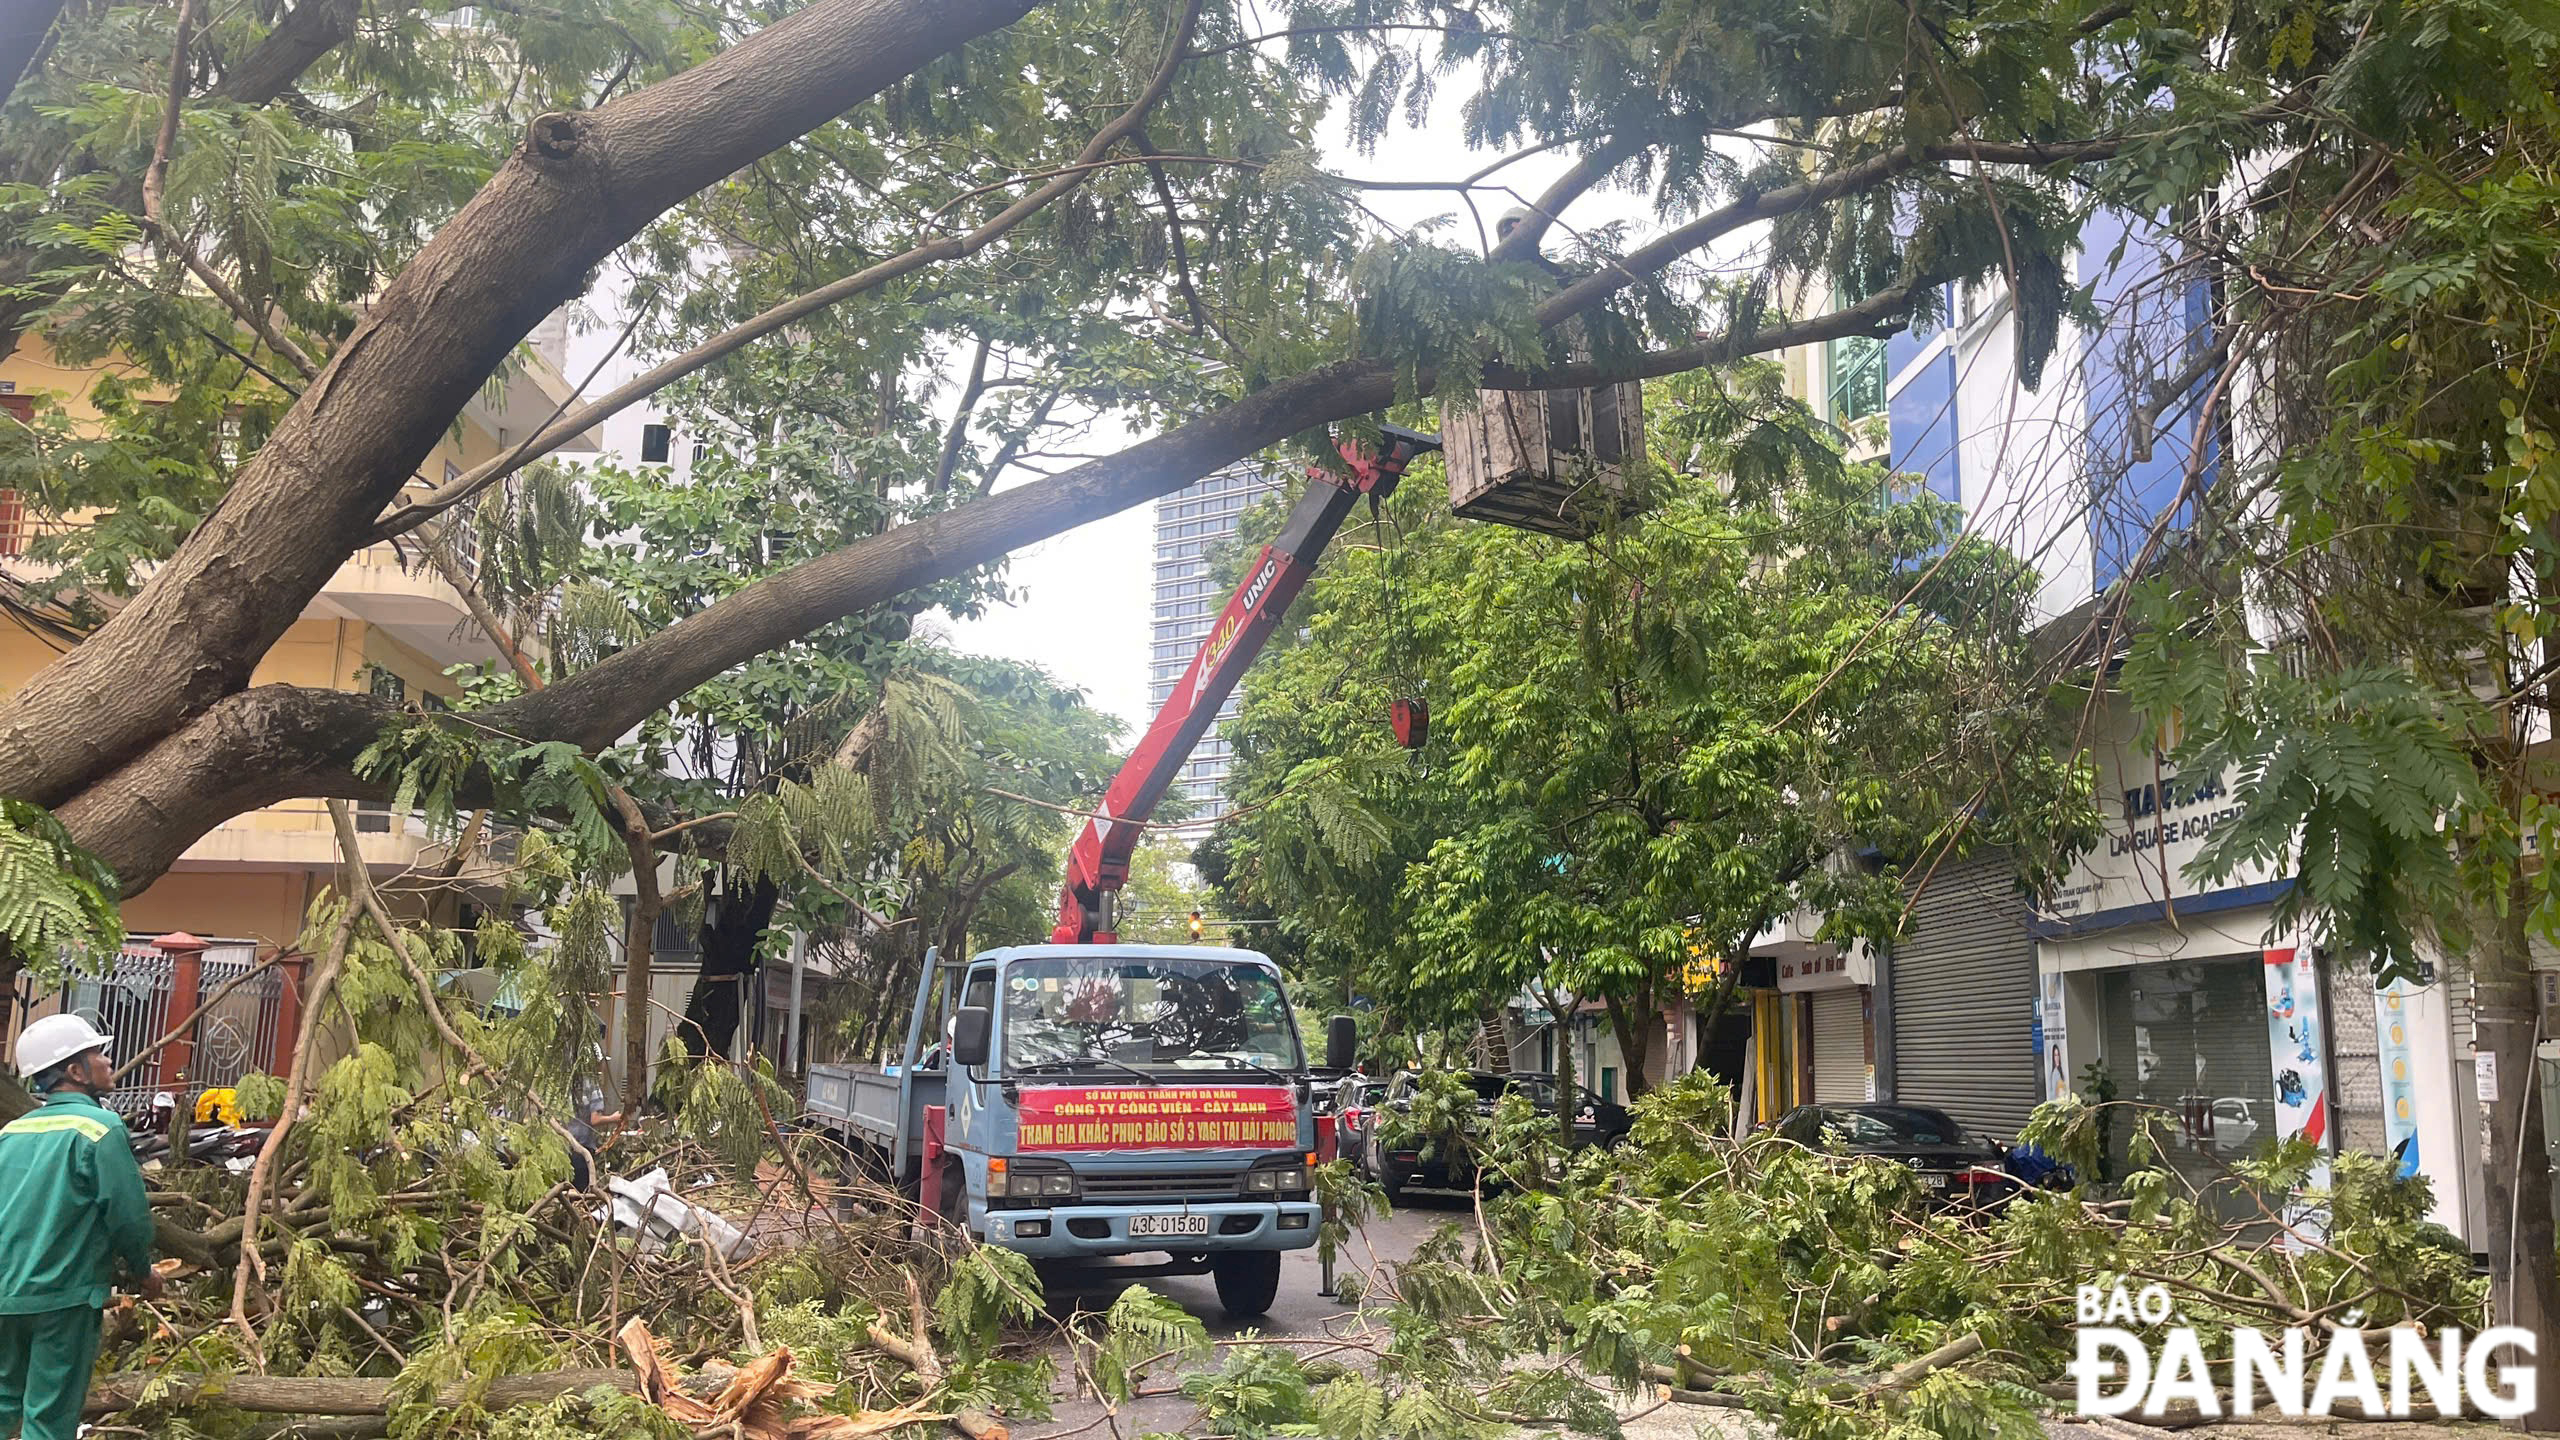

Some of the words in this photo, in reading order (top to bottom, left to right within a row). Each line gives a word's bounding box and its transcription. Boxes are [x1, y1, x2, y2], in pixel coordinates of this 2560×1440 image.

[1242, 560, 1275, 610] UNIC
[1208, 615, 1235, 668] 340
[1054, 1102, 1095, 1116] CÔNG
[1098, 1103, 1115, 1114] TY
[1119, 1101, 1158, 1114] CÔNG
[1161, 1101, 1192, 1113] VIÊN
[1203, 1101, 1229, 1113] CÂY
[1232, 1102, 1267, 1113] XANH
[1020, 1124, 1053, 1145] THAM
[1055, 1123, 1076, 1144] GIA
[1078, 1117, 1109, 1144] KHẮC
[1112, 1122, 1143, 1146] PHỤC
[1145, 1119, 1168, 1142] BÃO
[1170, 1115, 1185, 1142] SỐ
[1187, 1121, 1195, 1141] 3
[1197, 1121, 1221, 1141] YAGI
[1223, 1121, 1240, 1145] TẠI
[1242, 1116, 1260, 1141] HẢI
[1262, 1118, 1296, 1141] PHÒNG
